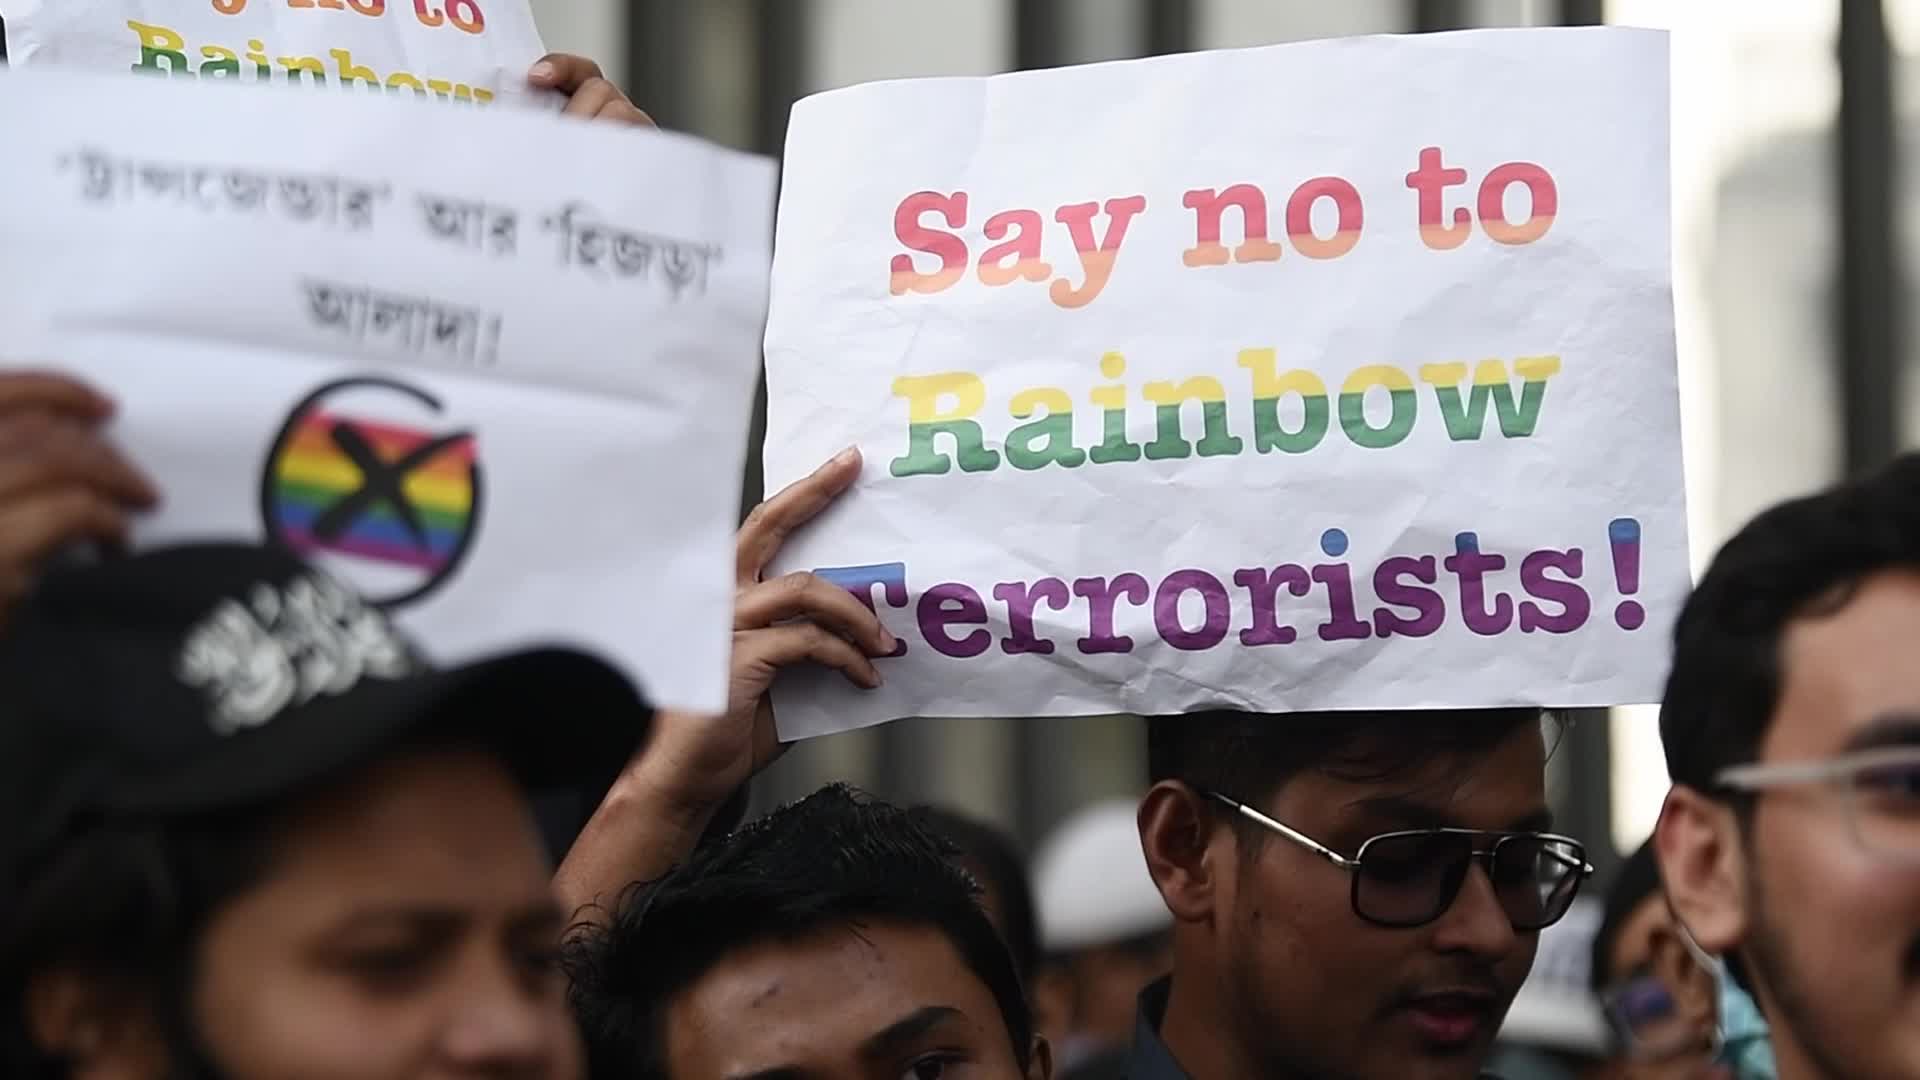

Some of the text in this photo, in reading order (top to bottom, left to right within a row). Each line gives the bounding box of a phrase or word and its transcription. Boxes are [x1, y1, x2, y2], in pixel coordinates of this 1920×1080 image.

[413, 194, 517, 256] আর
[890, 147, 1558, 309] Say no to
[889, 348, 1561, 478] Rainbow
